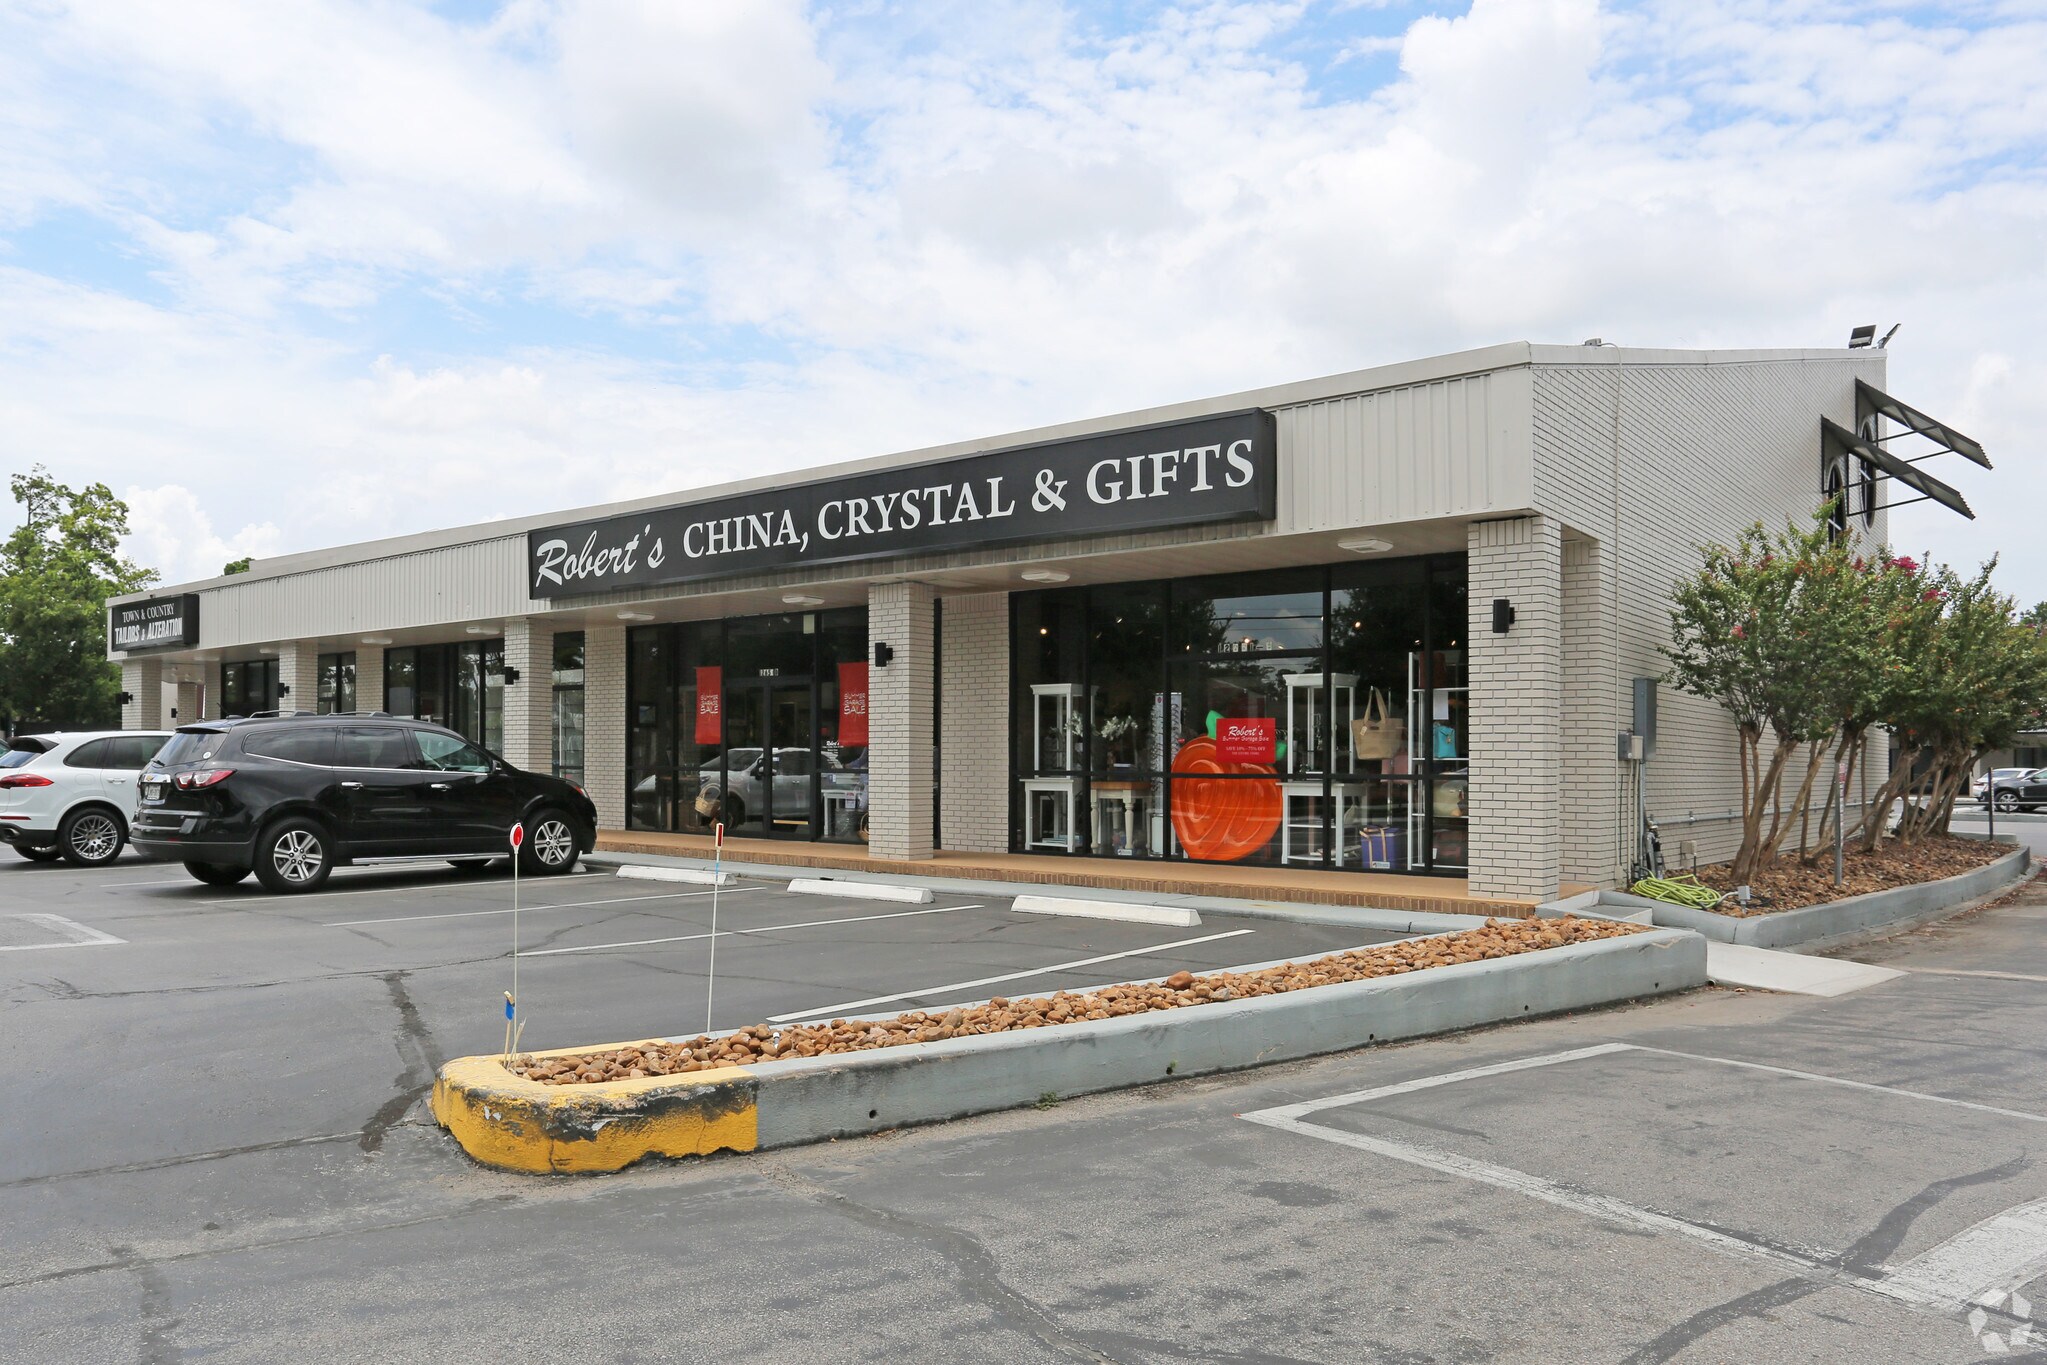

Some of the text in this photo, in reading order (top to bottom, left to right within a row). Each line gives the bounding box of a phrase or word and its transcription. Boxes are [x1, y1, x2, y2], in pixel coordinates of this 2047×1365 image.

[536, 439, 1255, 587] Robert's CHINA, CRYSTAL & GIFTS
[122, 603, 175, 623] TOWN & COUNTRY
[115, 624, 140, 645] TAILORS
[147, 617, 183, 640] ALTERATION
[700, 704, 718, 715] SALE
[844, 704, 866, 715] SALE
[1228, 725, 1264, 737] Robert's
